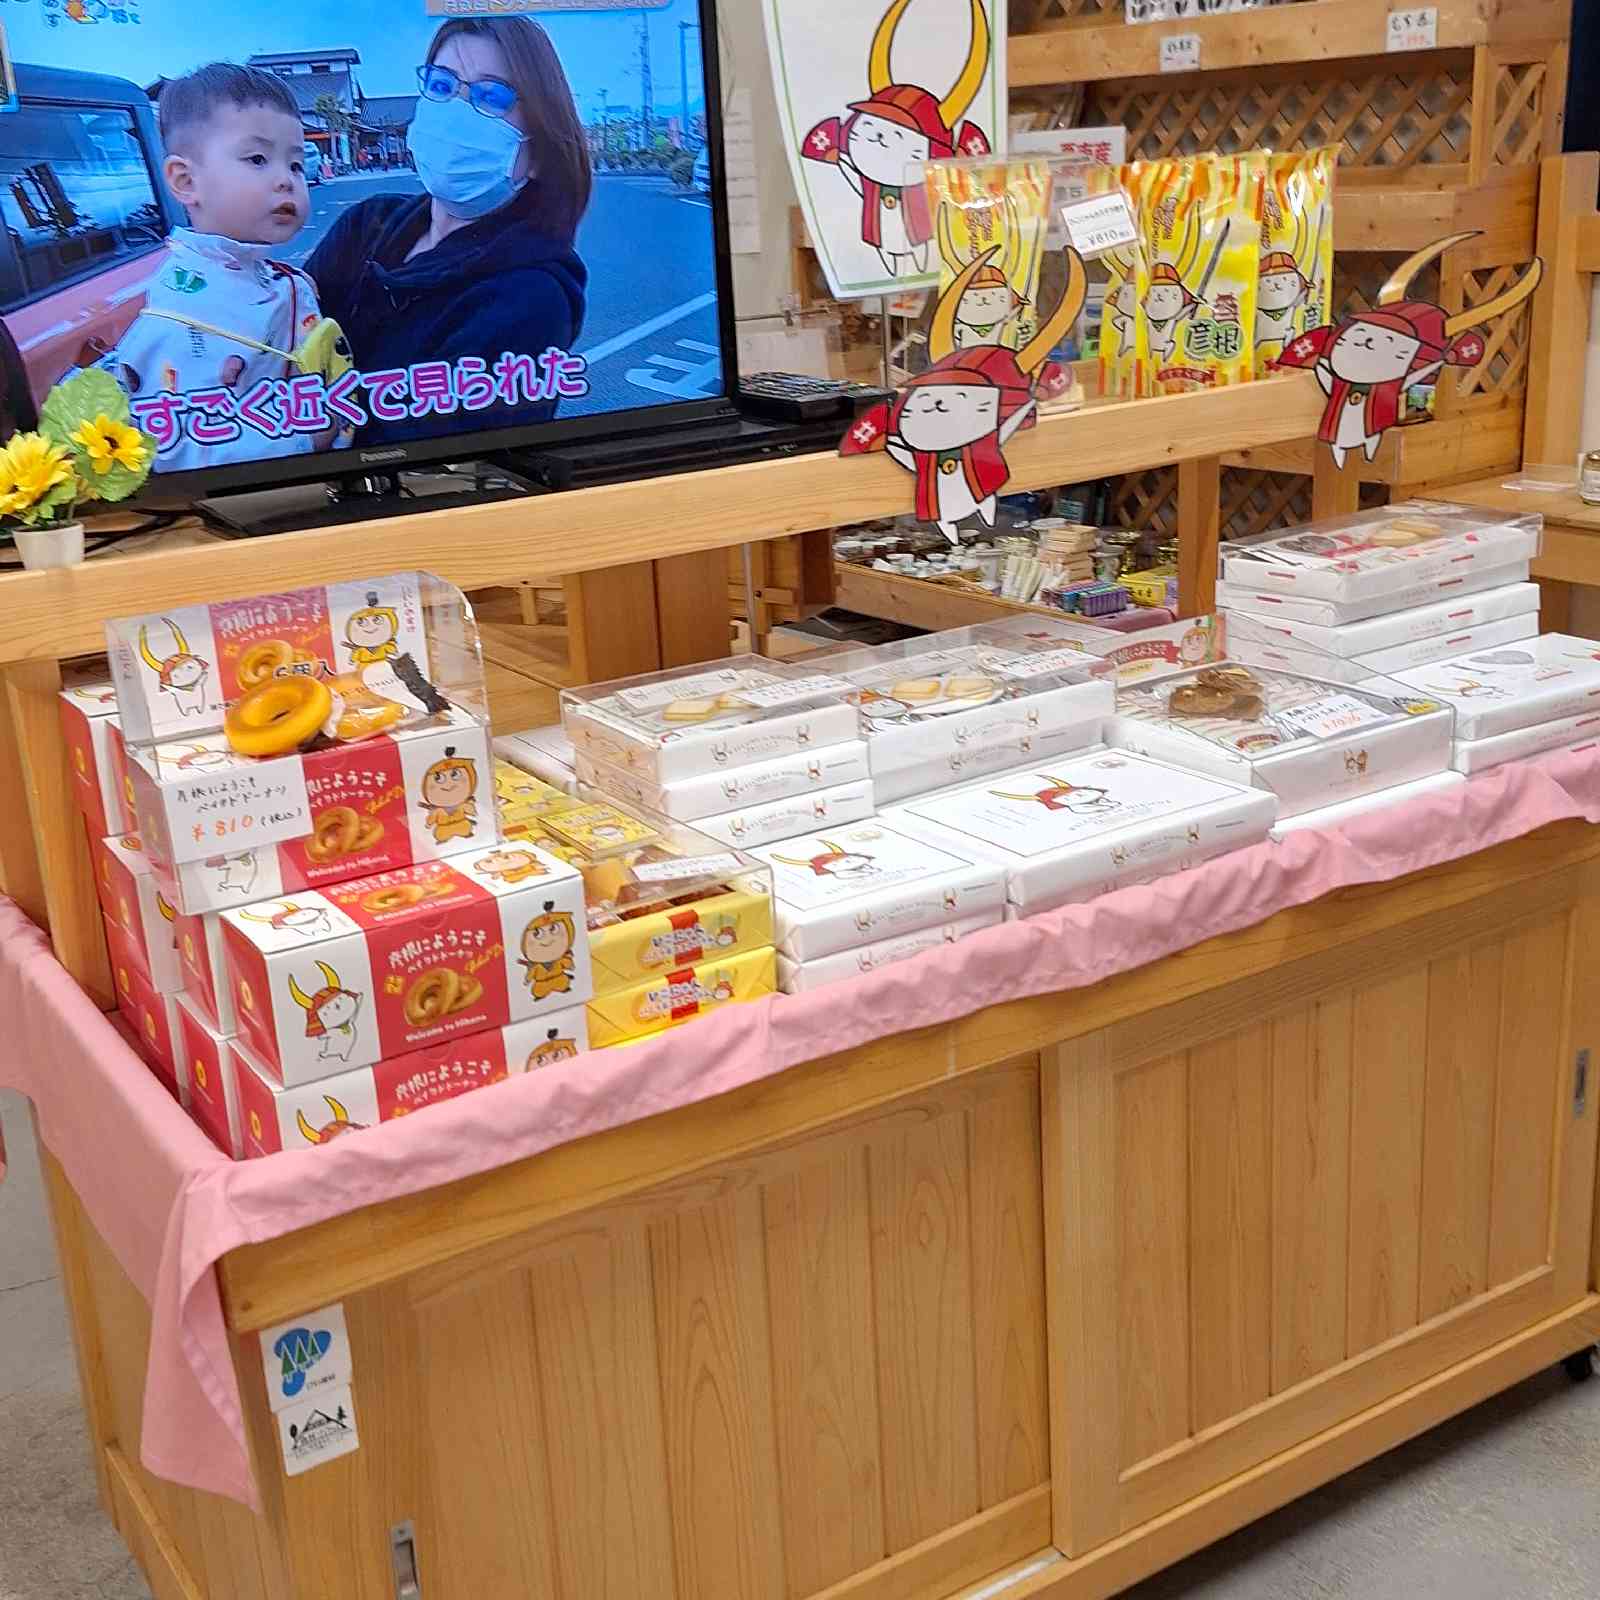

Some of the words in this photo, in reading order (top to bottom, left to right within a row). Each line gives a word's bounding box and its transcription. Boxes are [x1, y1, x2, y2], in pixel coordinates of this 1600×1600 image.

[1185, 323, 1240, 354] 彦根
[131, 348, 588, 455] すごく近くで見られた
